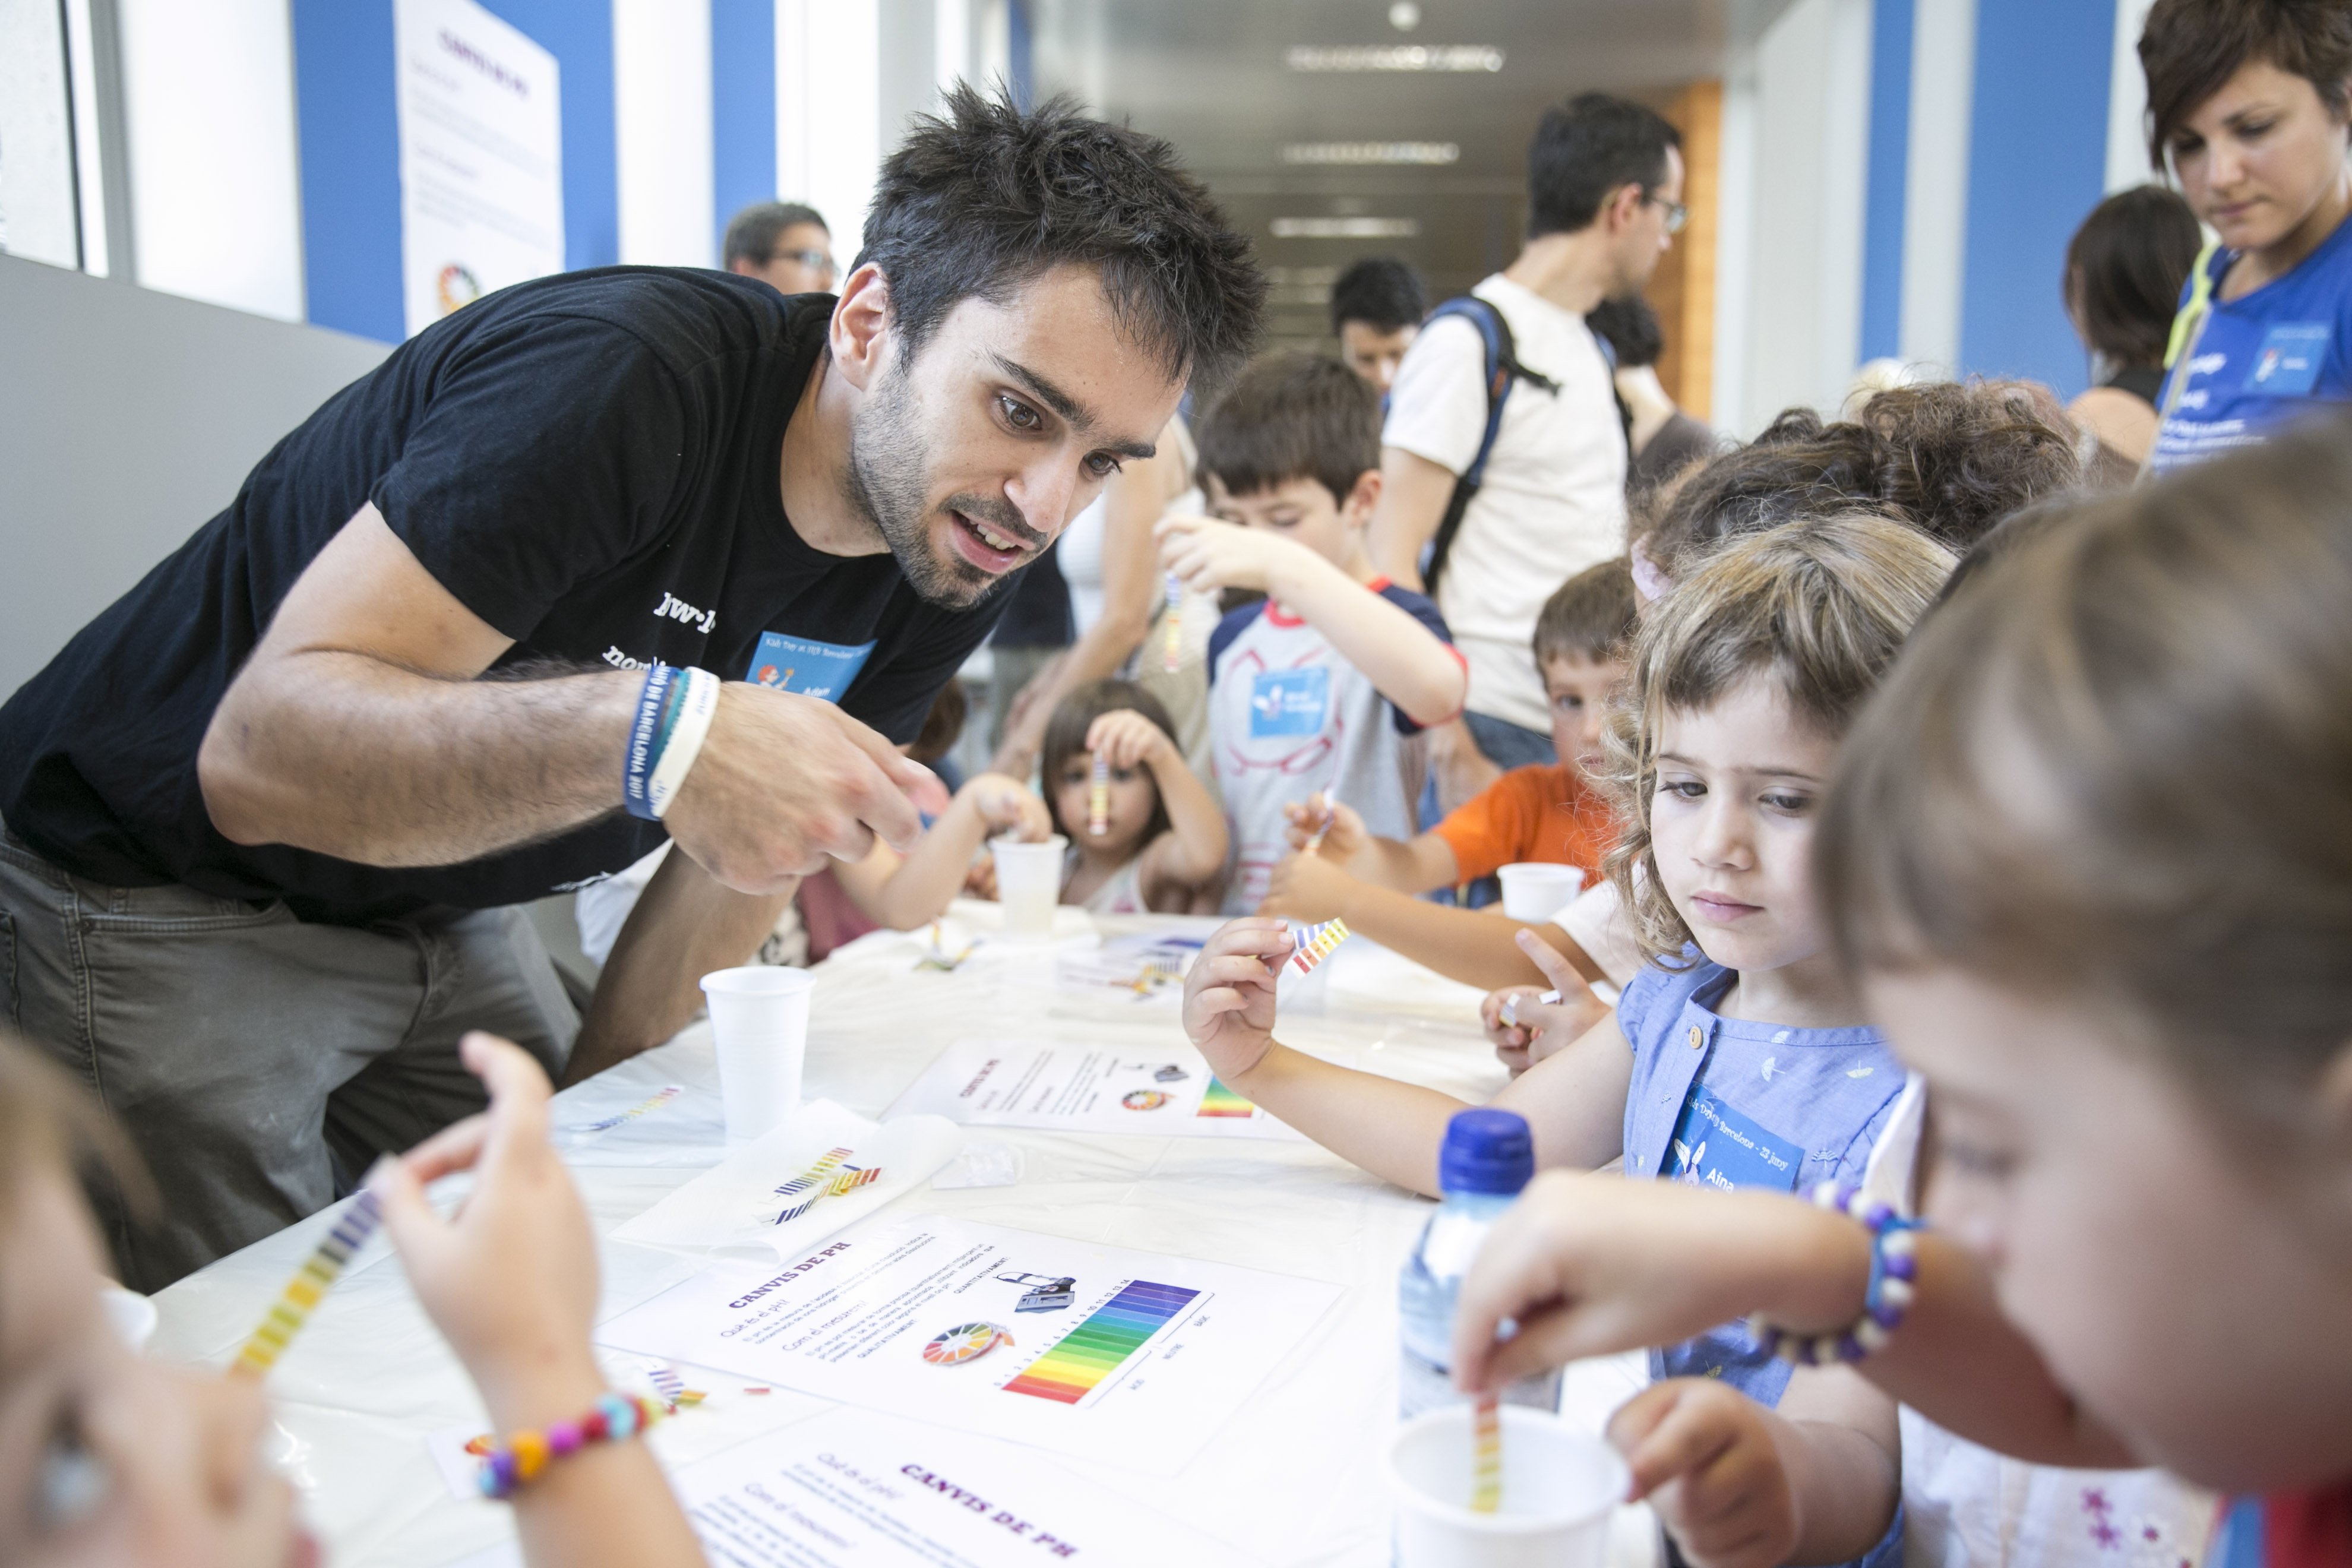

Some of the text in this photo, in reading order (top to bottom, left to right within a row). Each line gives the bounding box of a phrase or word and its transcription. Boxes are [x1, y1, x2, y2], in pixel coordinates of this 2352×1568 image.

[645, 685, 663, 701] DE
[630, 701, 659, 774] BARCELONA
[628, 774, 644, 800] 2017
[1719, 1121, 1754, 1149] Barcelona
[1759, 1147, 1771, 1159] 23
[1768, 1152, 1788, 1171] juny
[1706, 1168, 1734, 1194] Aina
[729, 1242, 852, 1308] CANVIS DE PH
[900, 1464, 993, 1513] CANVIS
[991, 1511, 1033, 1534] DE
[1031, 1532, 1079, 1557] PH
